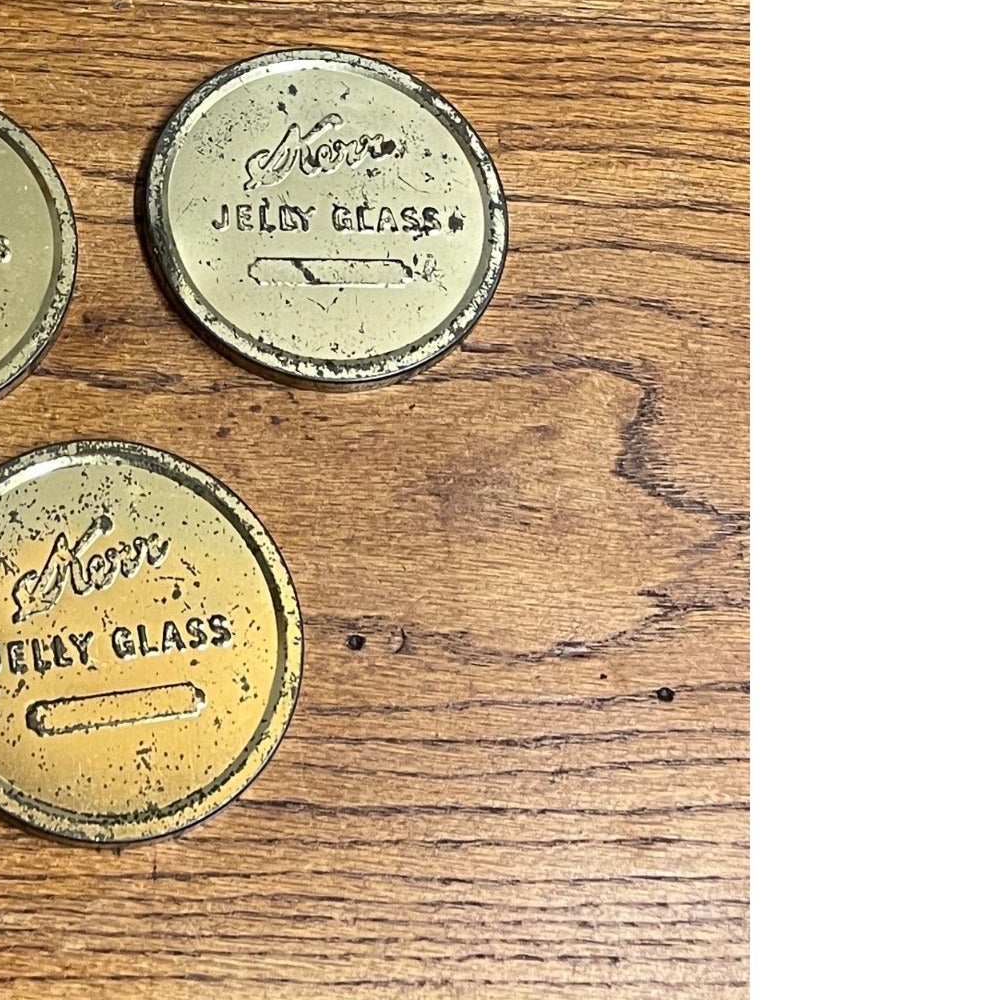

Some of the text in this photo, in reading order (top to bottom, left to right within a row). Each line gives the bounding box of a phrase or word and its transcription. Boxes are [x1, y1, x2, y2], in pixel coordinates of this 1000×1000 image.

[243, 113, 396, 191] Kerr
[211, 202, 443, 234] JELLY GLASS
[11, 515, 171, 624] Kerr
[111, 614, 234, 660] GLASS
